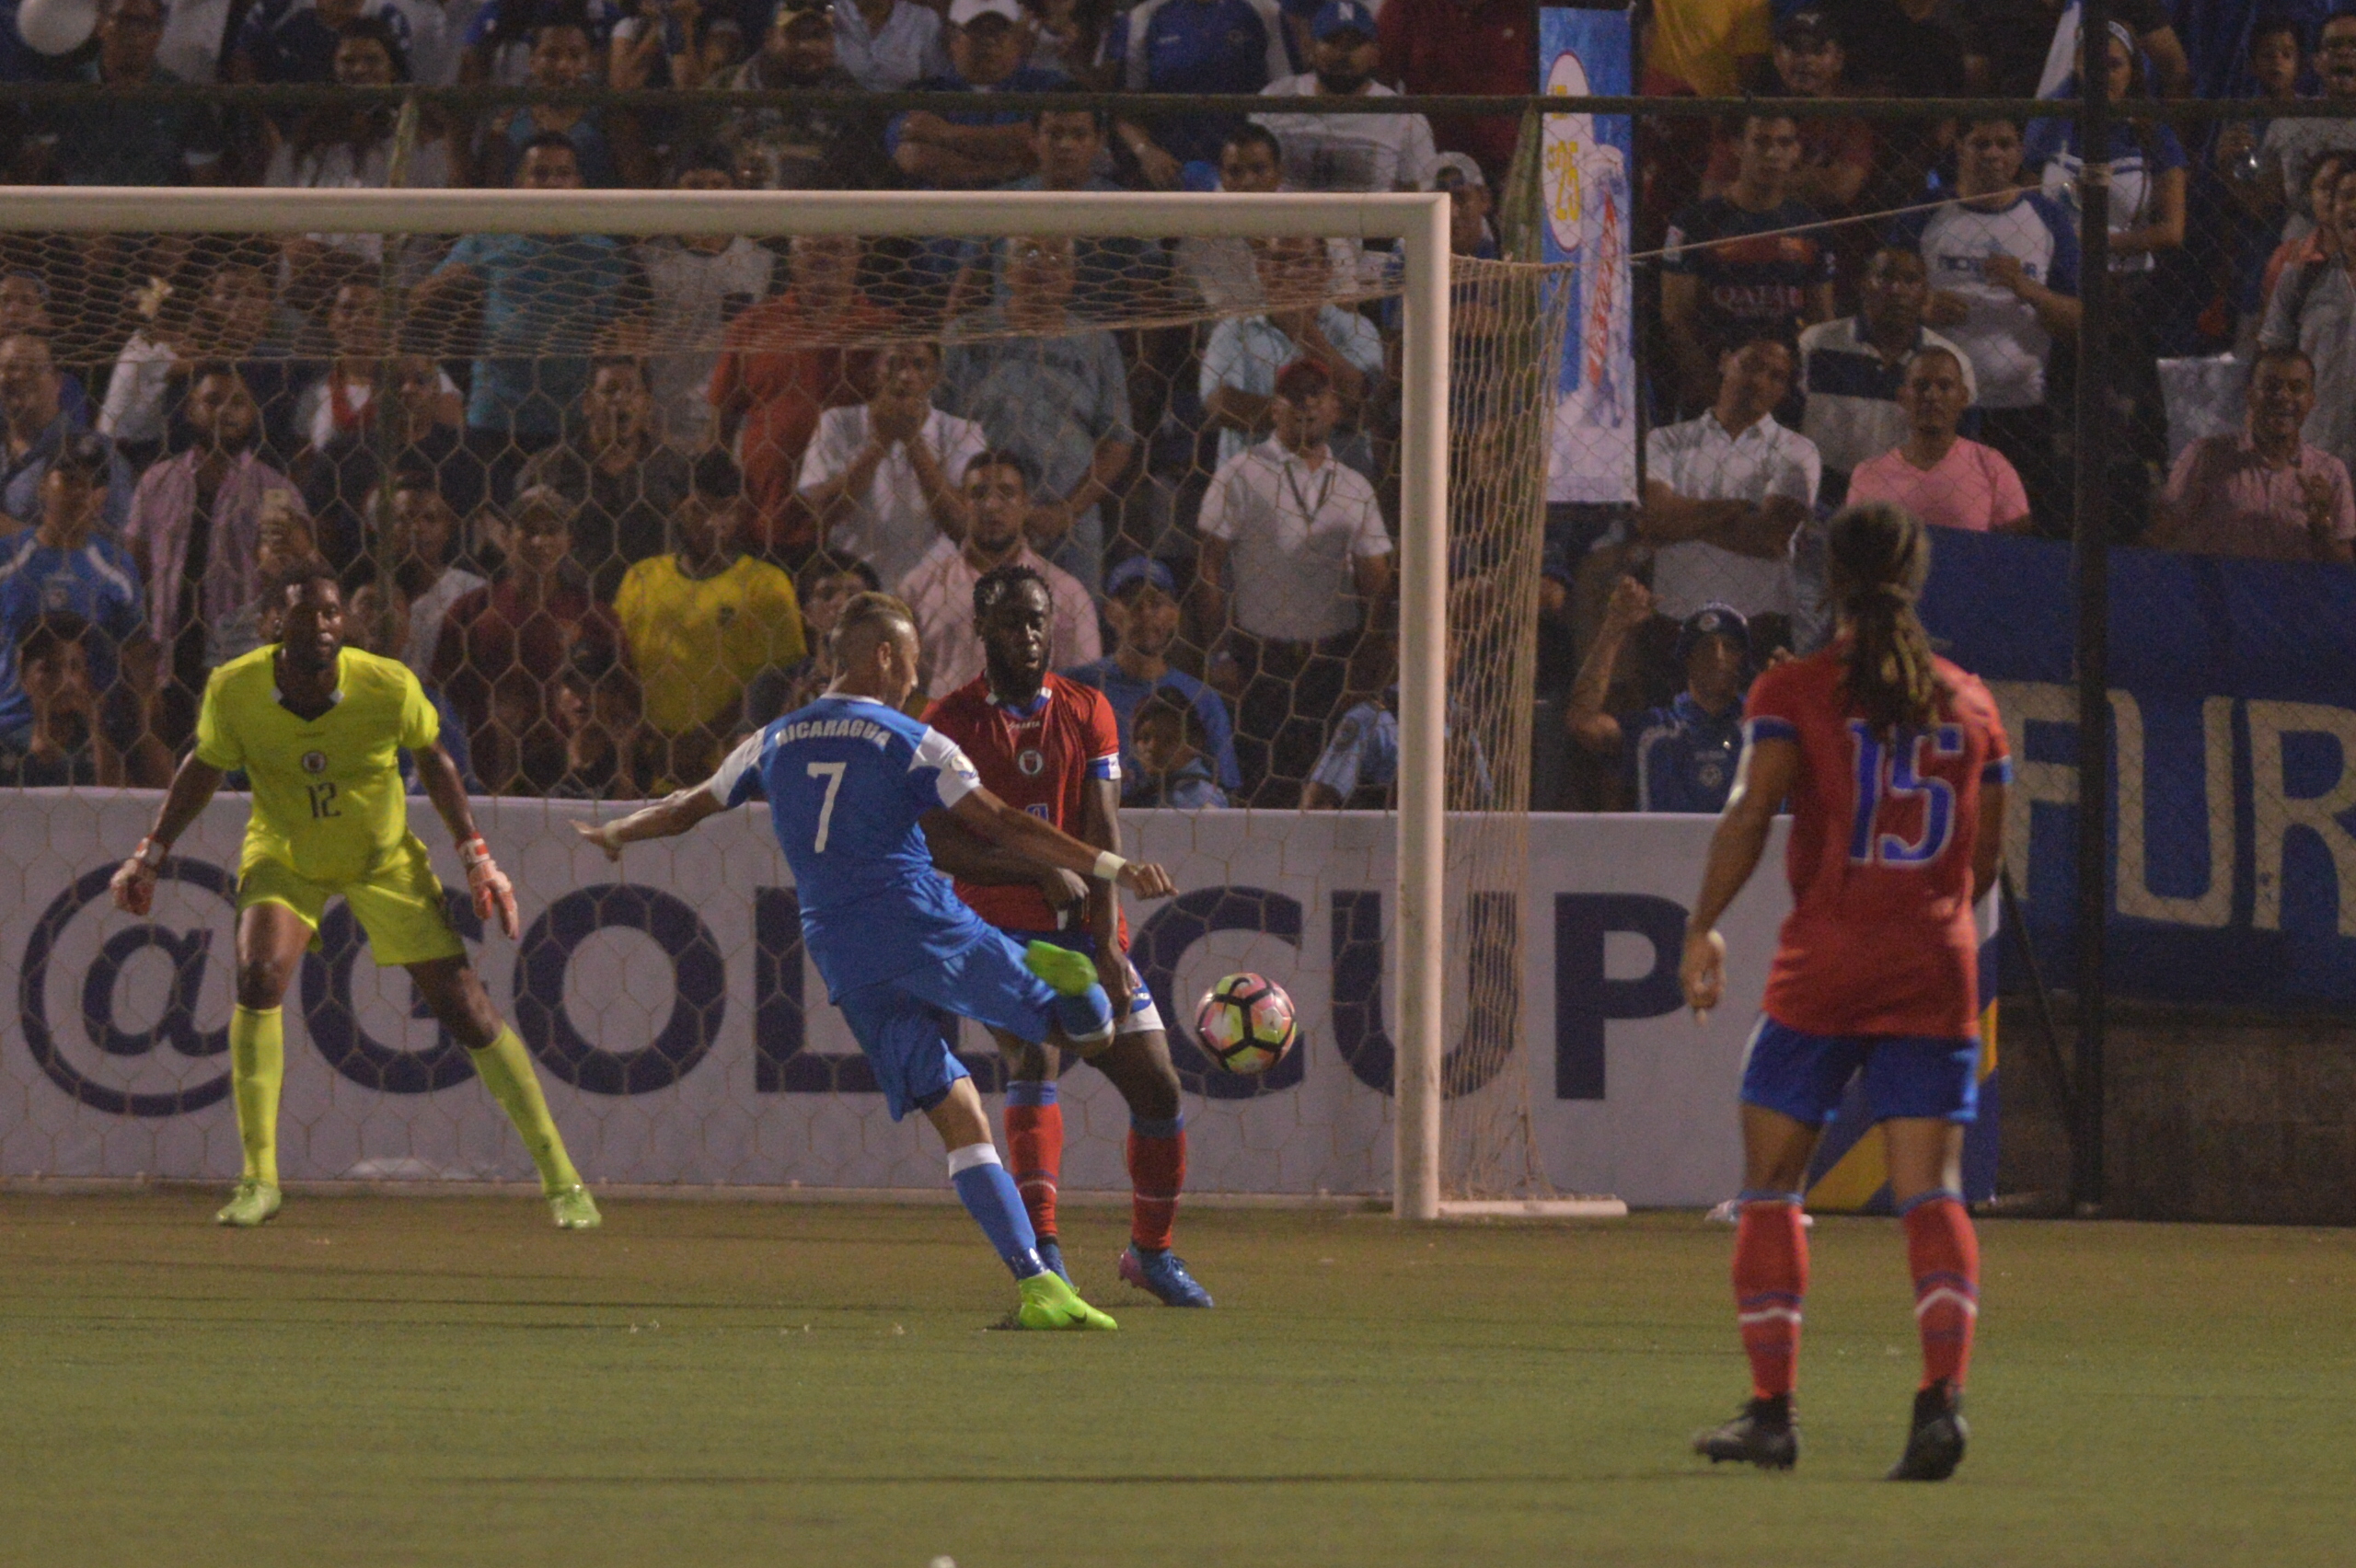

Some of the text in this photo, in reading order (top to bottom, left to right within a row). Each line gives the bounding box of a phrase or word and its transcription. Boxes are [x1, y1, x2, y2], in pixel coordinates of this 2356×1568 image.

[775, 719, 891, 747] NICARAGUA
[307, 782, 341, 817] 12
[806, 761, 847, 854] 7
[1845, 717, 1965, 866] 15
[18, 856, 1693, 1117] @GOLCUP
